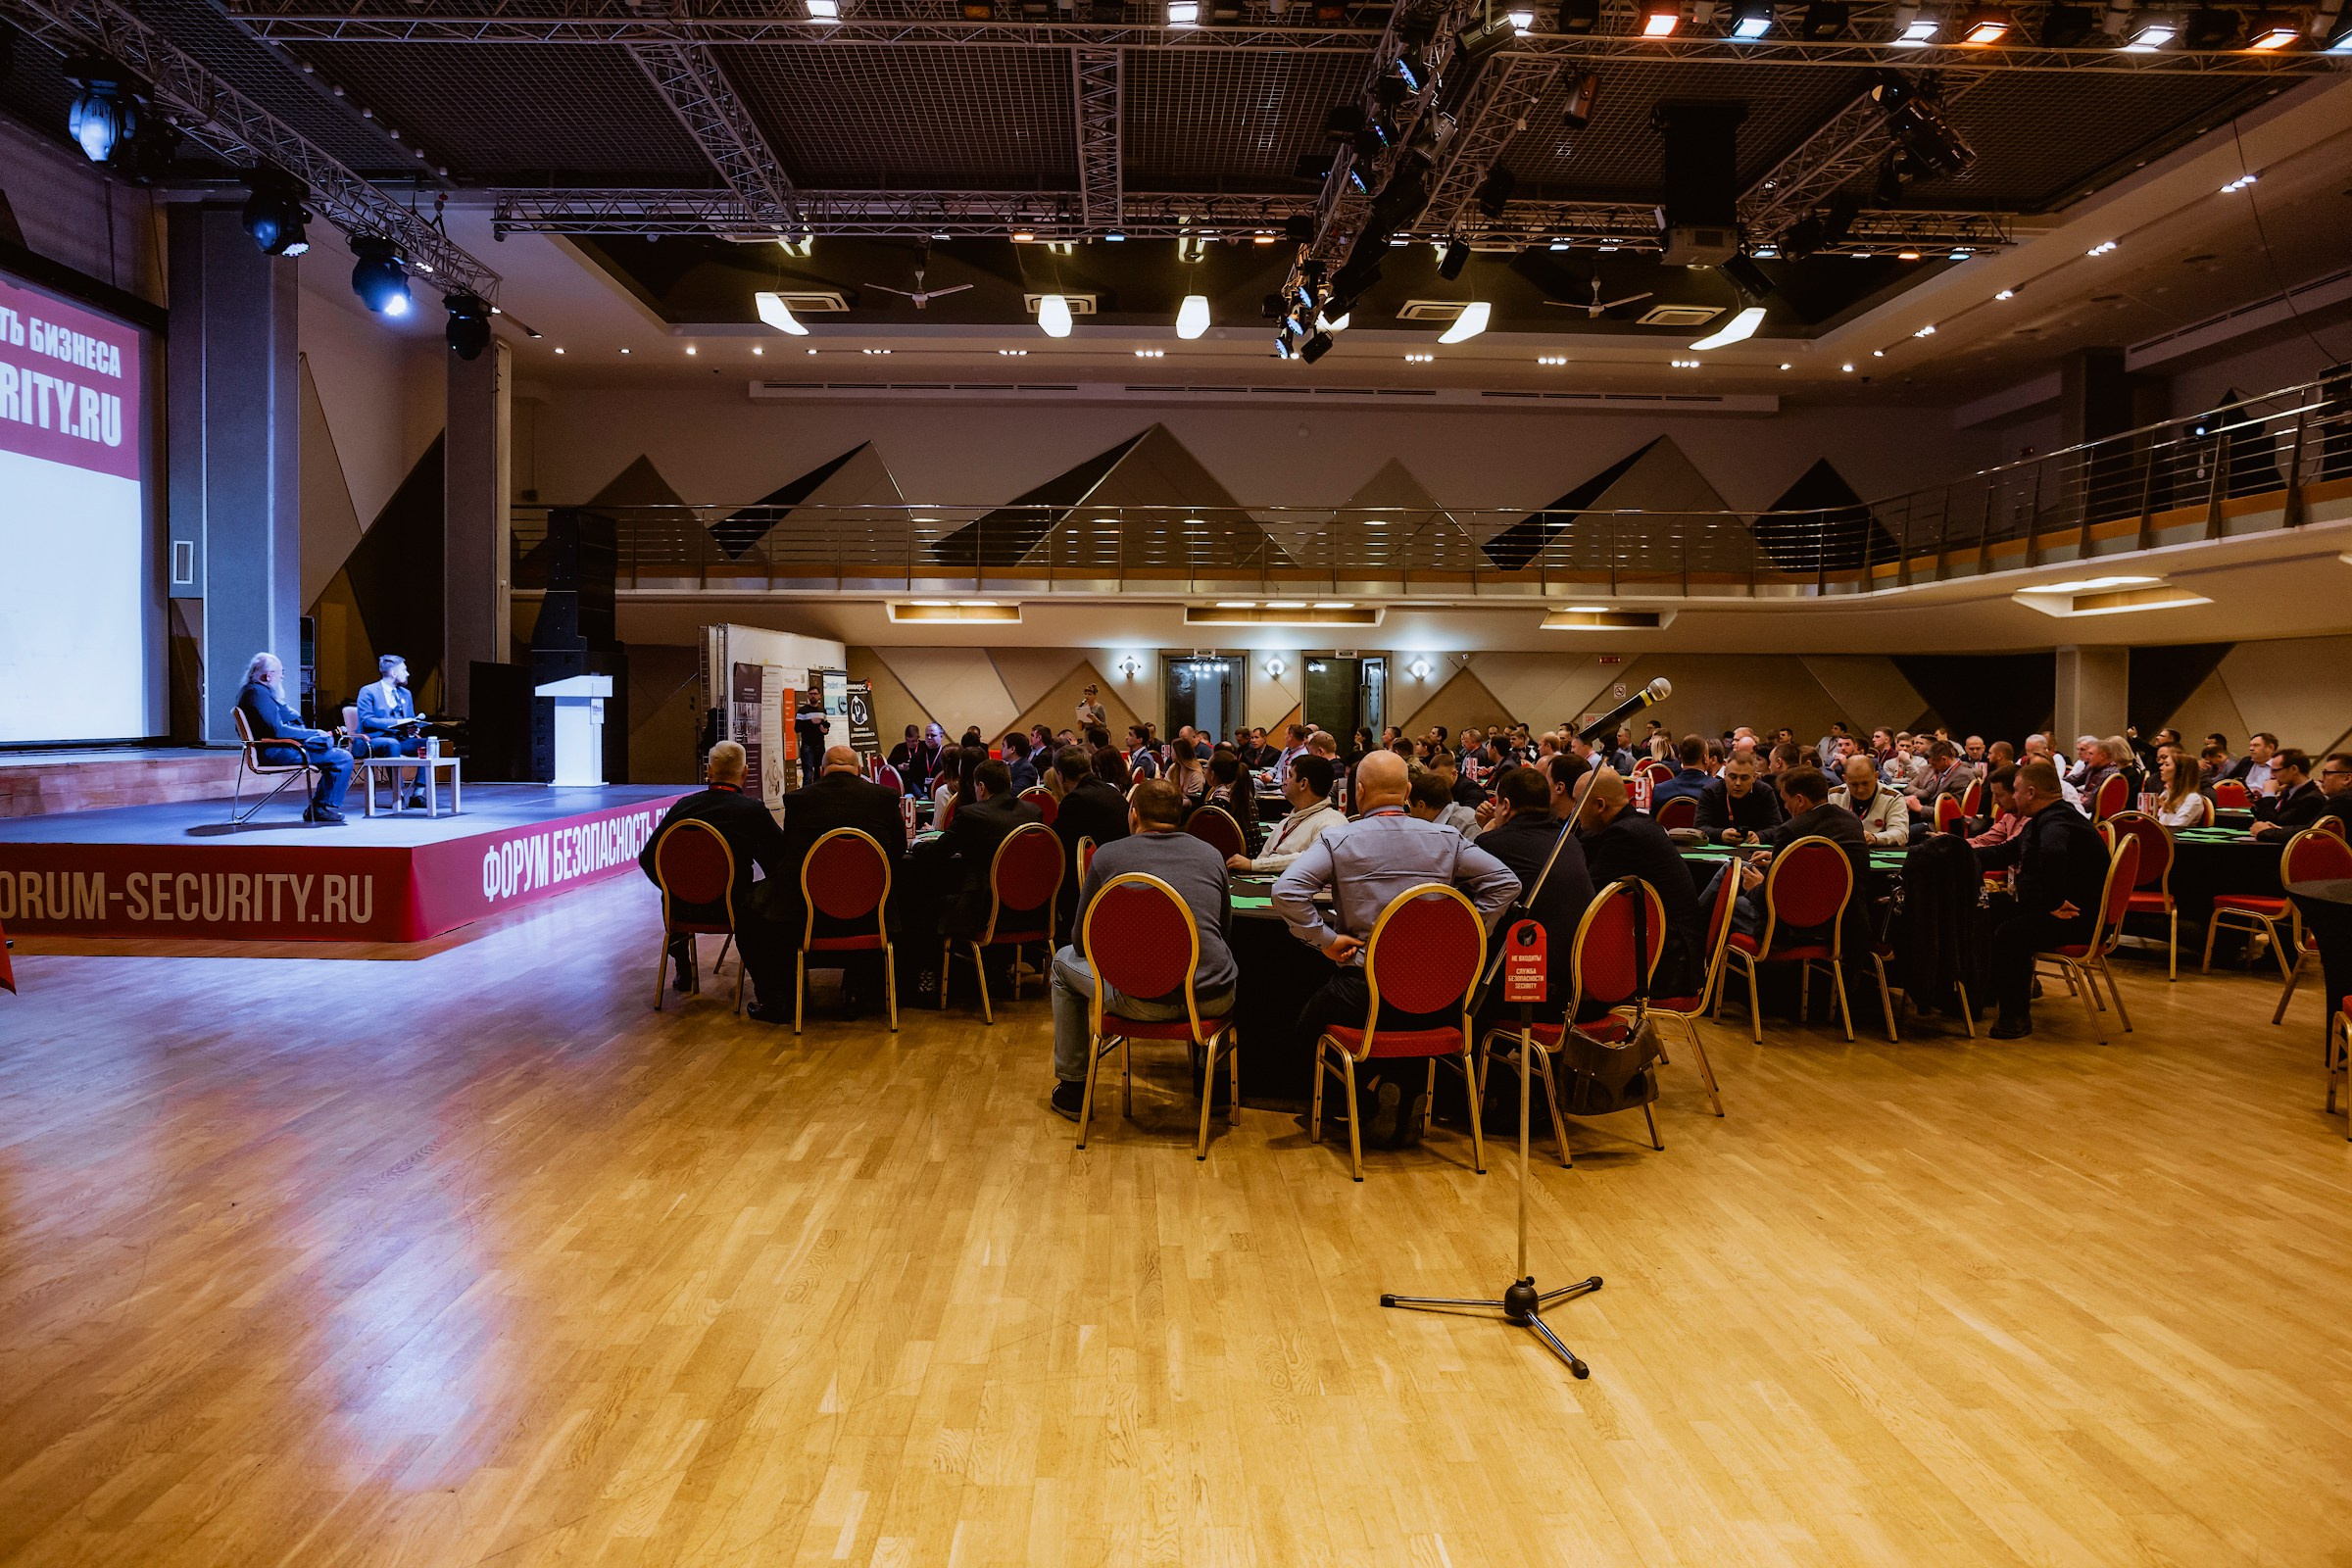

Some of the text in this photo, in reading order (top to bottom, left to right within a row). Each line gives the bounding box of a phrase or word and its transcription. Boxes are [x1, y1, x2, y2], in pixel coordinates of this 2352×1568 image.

[29, 317, 122, 378] БИЗНЕСА
[0, 361, 122, 447] RITY.RU
[905, 797, 913, 829] 9
[1635, 777, 1646, 801] 9
[483, 833, 550, 903] ФОРУМ
[0, 870, 373, 924] ORUM-SECURITY.RU
